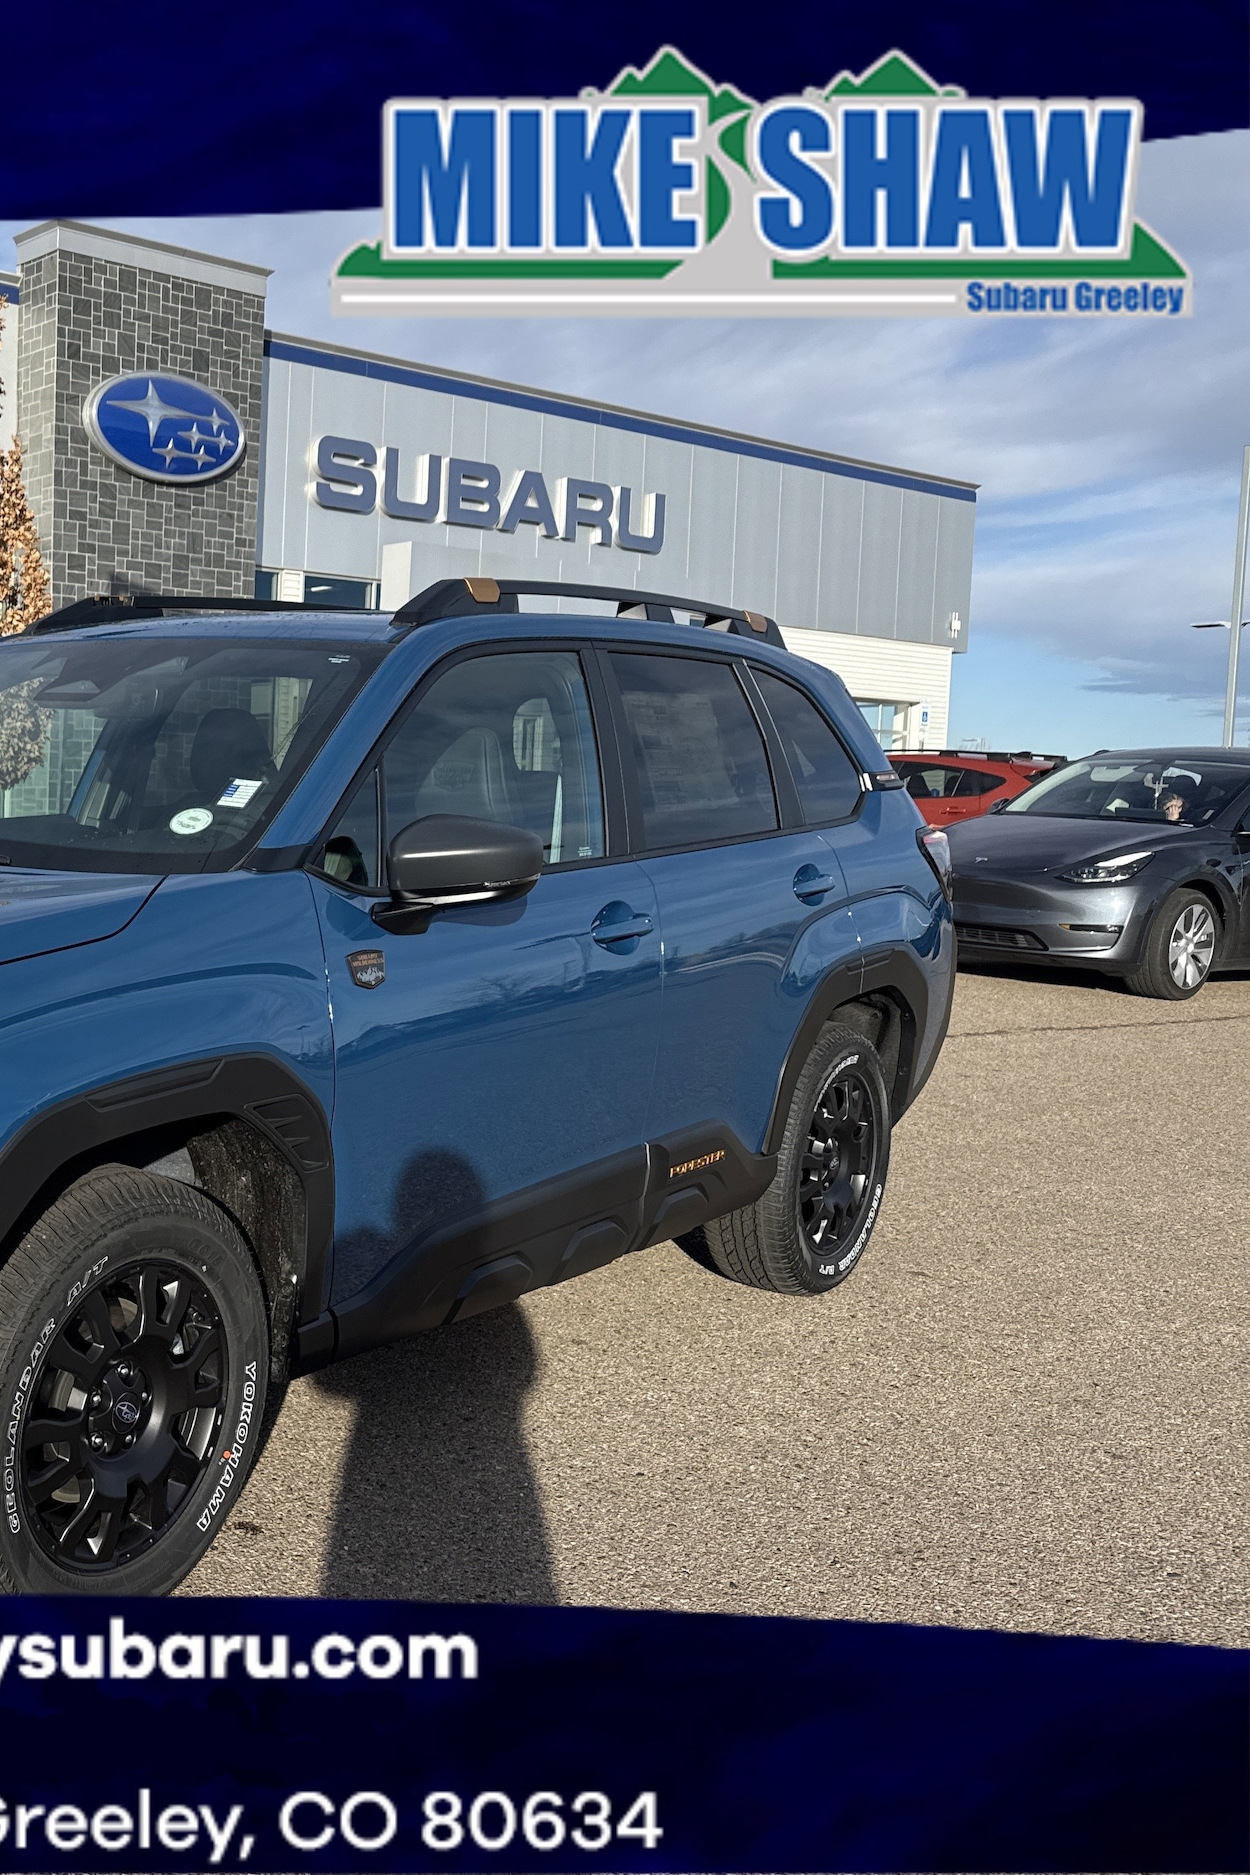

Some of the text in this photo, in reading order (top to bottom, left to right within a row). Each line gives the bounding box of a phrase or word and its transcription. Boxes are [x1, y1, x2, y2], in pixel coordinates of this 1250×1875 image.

[316, 435, 667, 555] SUBARU
[669, 1150, 726, 1179] FORESTER
[5, 1256, 108, 1534] GEOLANDAR A/T
[197, 1361, 257, 1532] YOKOHAMA
